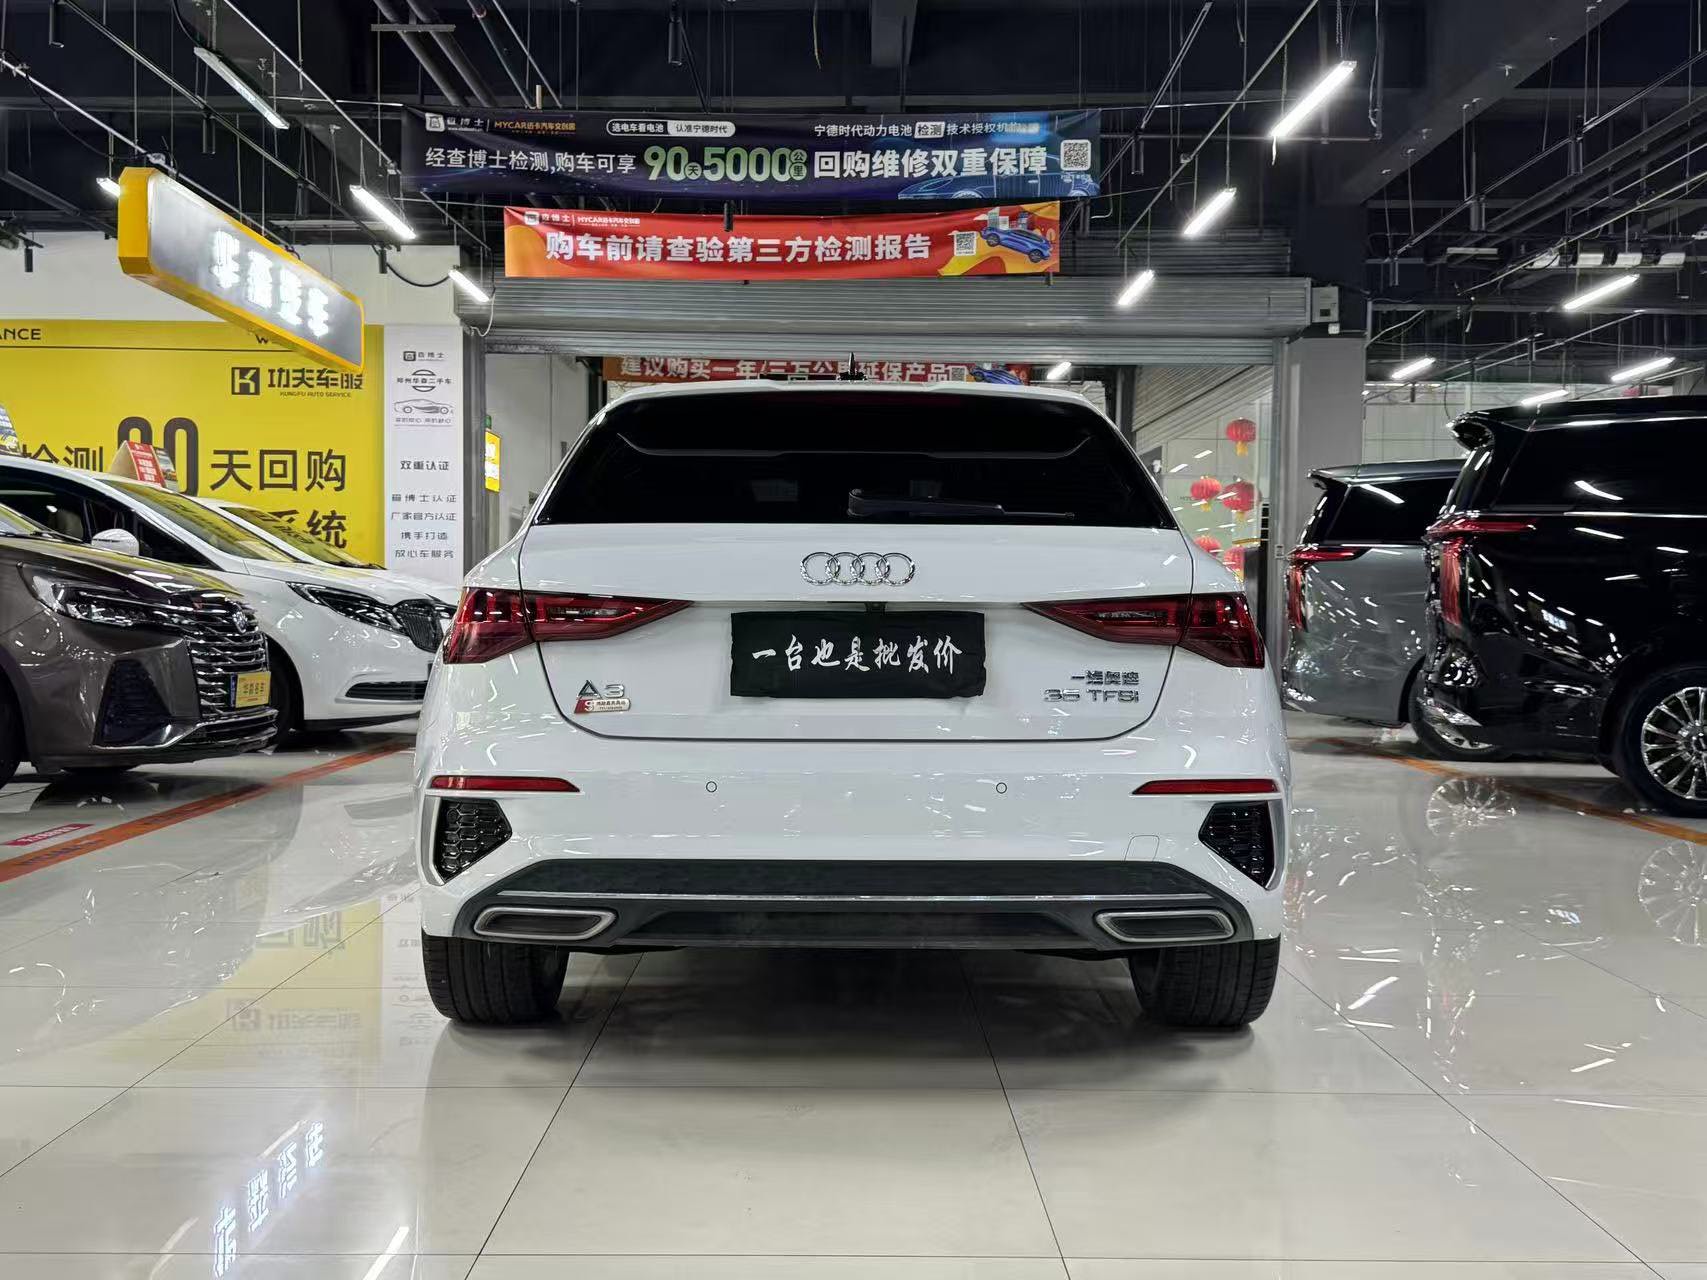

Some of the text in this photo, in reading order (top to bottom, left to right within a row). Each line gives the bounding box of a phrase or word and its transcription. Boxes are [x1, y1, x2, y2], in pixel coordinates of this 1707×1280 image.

[611, 122, 664, 133] 选电车看电池
[675, 123, 729, 134] 认准宁德时代
[814, 123, 913, 137] 宁德时代动力电池
[916, 122, 943, 137] 检测
[425, 147, 636, 175] 经查博士检测,购车可享
[814, 146, 1047, 179] 回购维修双重保障
[545, 231, 932, 263] 购车前请查验第三方检测报告
[0, 328, 42, 340] NCE
[267, 367, 363, 389] 功夫车服
[210, 449, 347, 492] 天回购
[400, 460, 450, 471] 双重认证
[751, 633, 963, 675] 一台也是批发价
[577, 680, 625, 699] A3
[1044, 689, 1139, 702] 35 TFSI
